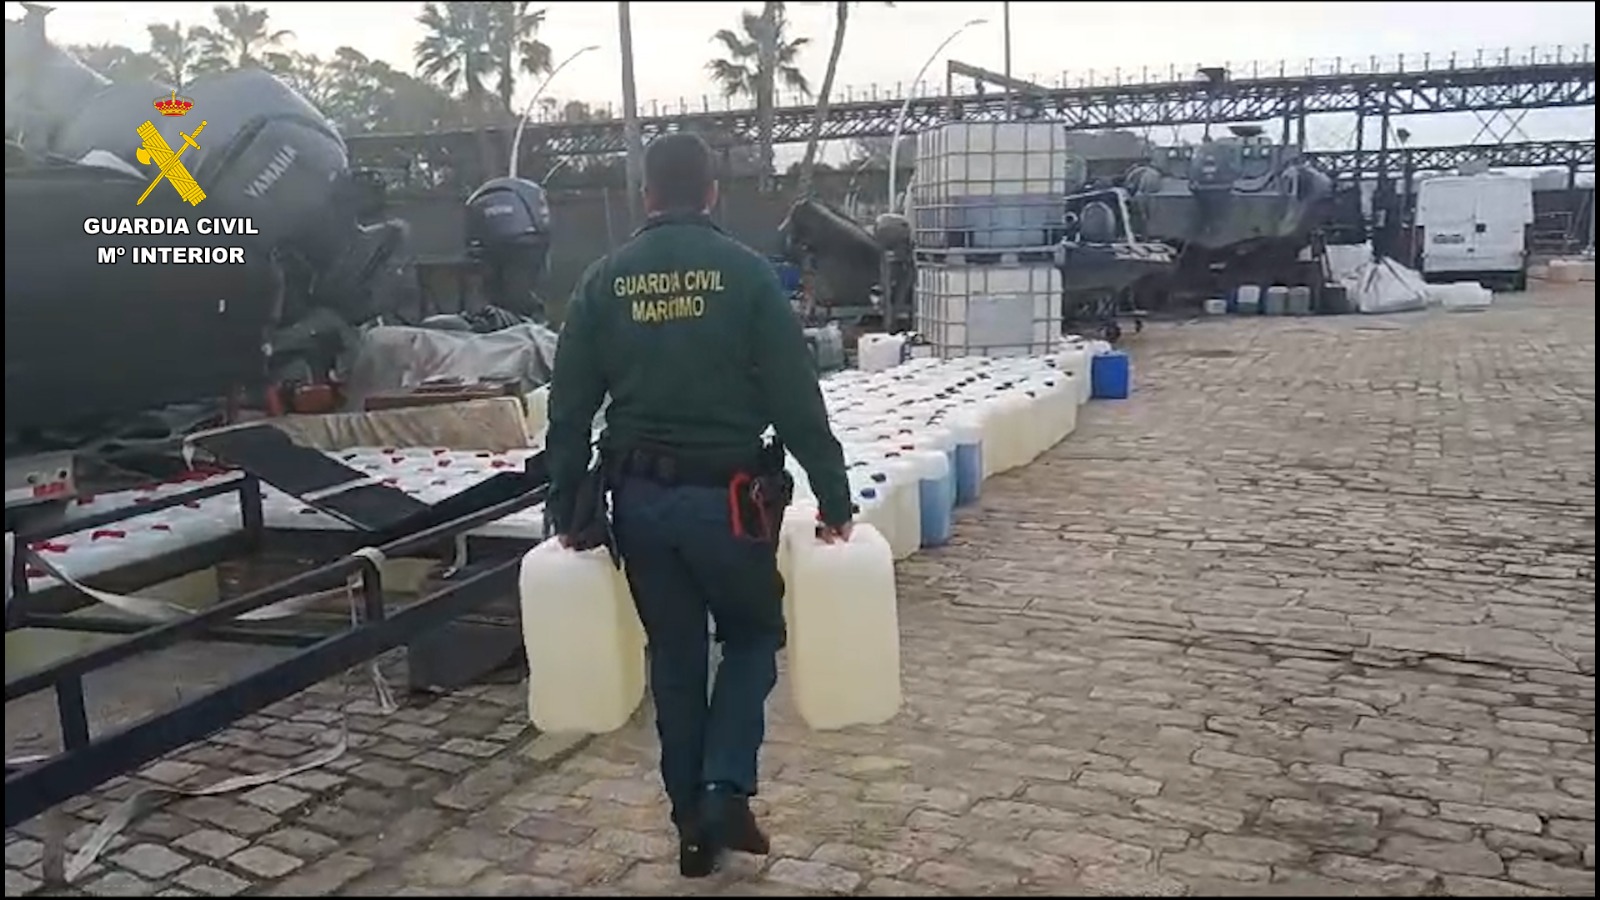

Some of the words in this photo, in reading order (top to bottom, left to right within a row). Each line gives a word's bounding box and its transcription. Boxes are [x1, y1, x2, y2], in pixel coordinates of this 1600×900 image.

[244, 146, 298, 197] YAMAHA
[614, 271, 681, 297] GUARDIA
[684, 270, 724, 292] CIVIL
